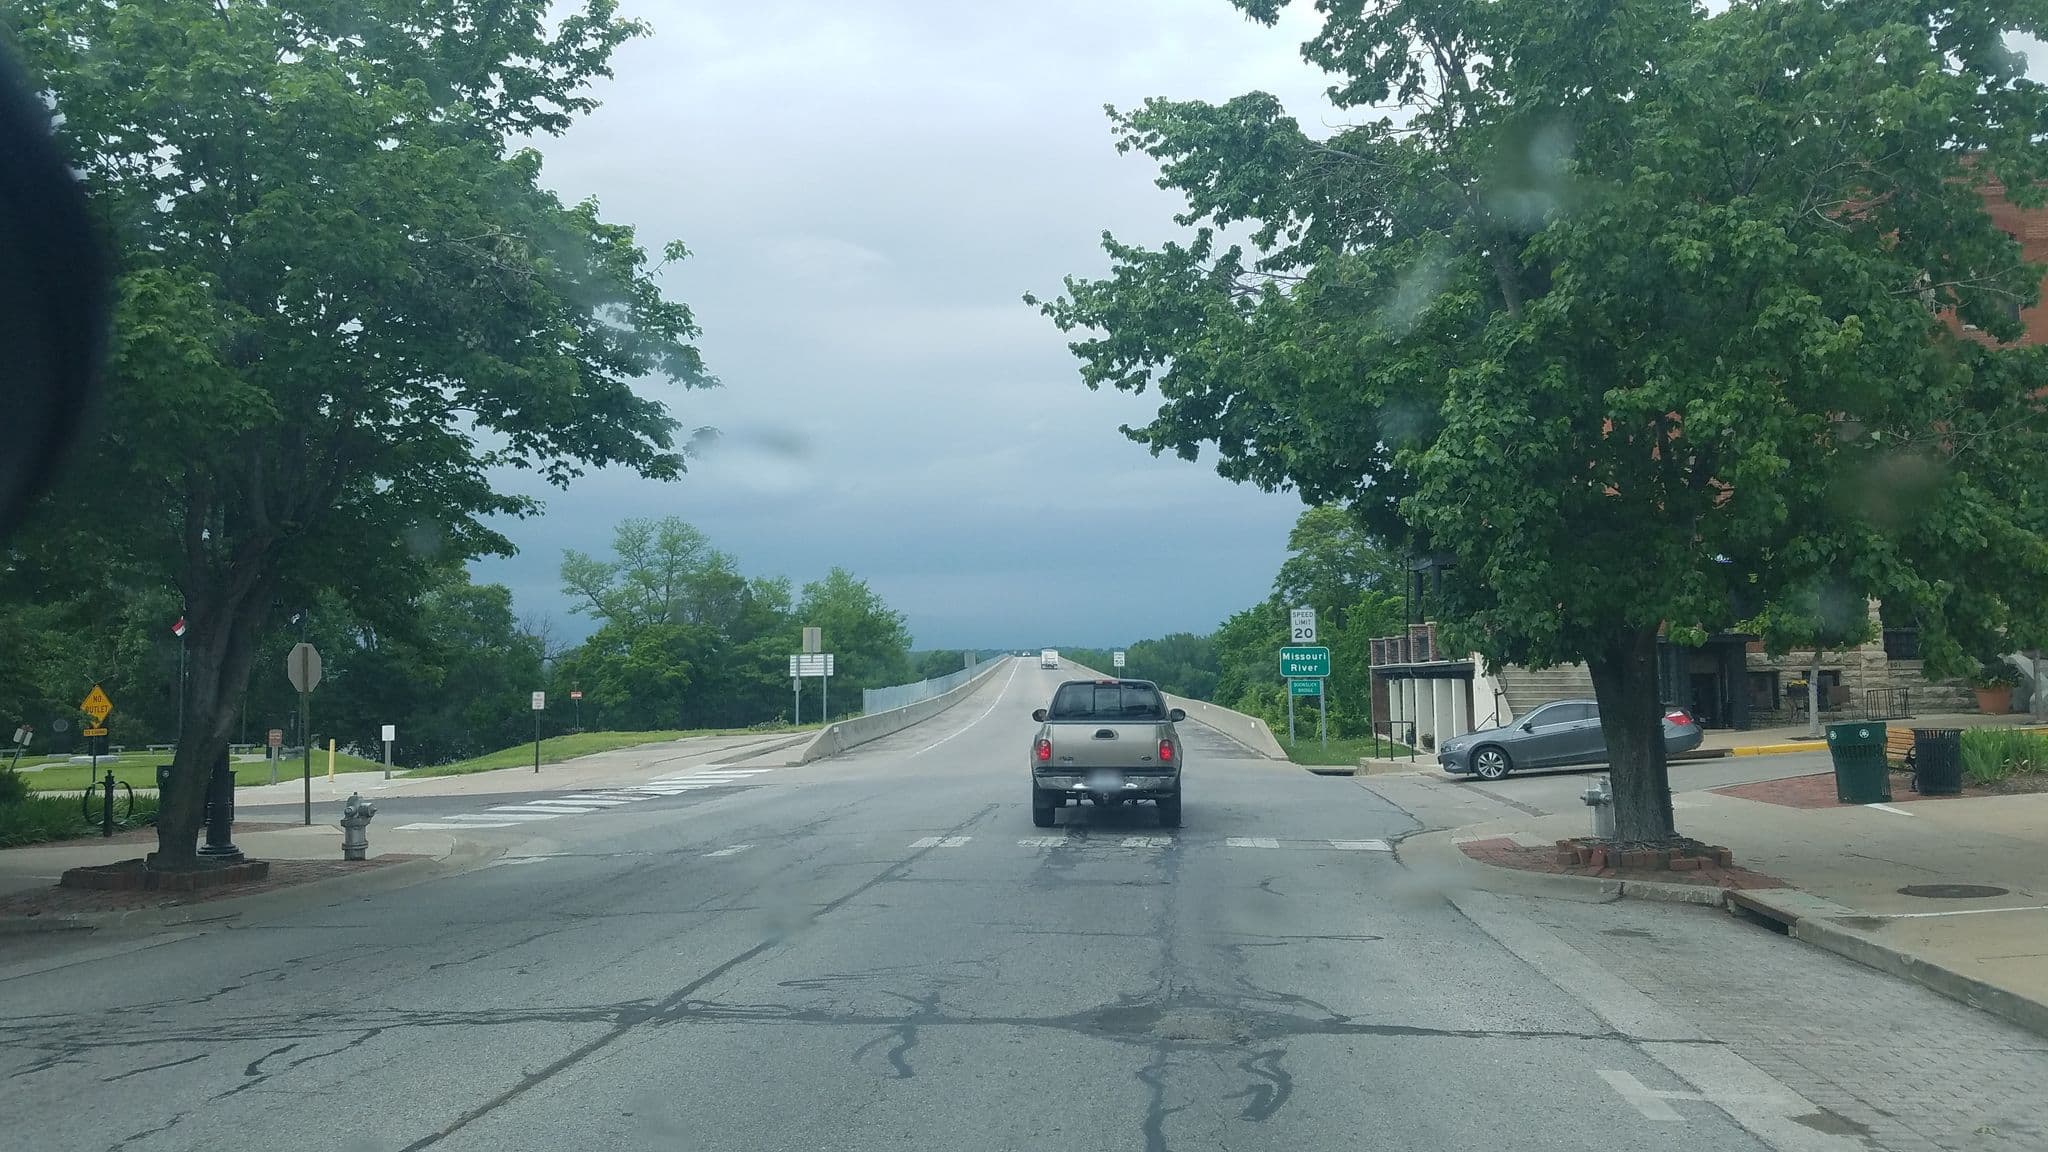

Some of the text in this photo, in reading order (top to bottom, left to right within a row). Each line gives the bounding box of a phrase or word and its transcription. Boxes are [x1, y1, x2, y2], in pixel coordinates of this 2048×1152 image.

[1294, 627, 1313, 639] 20
[1282, 652, 1326, 661] Missouri
[1290, 664, 1319, 672] River
[93, 695, 102, 703] NO
[86, 705, 108, 713] OUTLET
